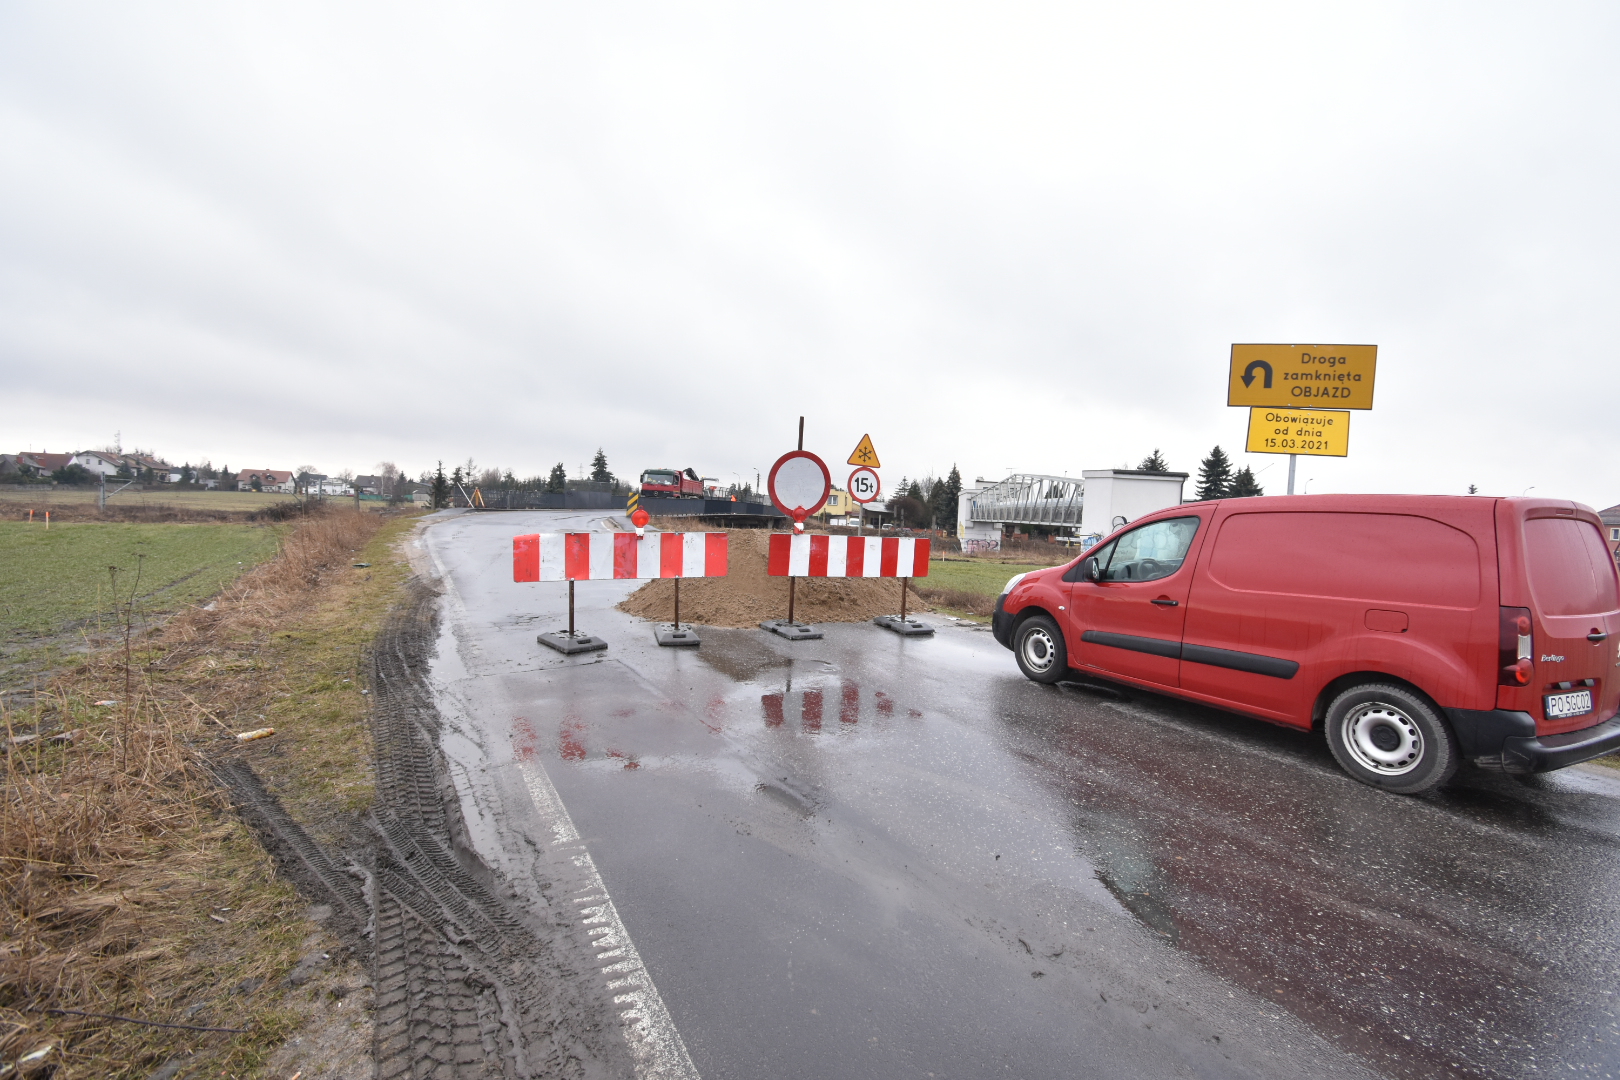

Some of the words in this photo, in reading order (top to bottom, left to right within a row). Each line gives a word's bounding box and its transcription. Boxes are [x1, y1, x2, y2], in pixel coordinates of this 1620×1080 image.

[1301, 352, 1347, 367] Droga
[1283, 370, 1362, 384] zamknięta
[1291, 386, 1351, 399] OBJAZD
[1265, 412, 1334, 427] Obowiązuje
[1274, 426, 1289, 436] od
[1296, 427, 1322, 438] dnia
[1264, 438, 1329, 450] 15.03.2021
[854, 477, 874, 493] 15t
[1541, 654, 1565, 662] Berlingo
[1550, 696, 1564, 714] PO
[1565, 693, 1591, 712] 5GC02
